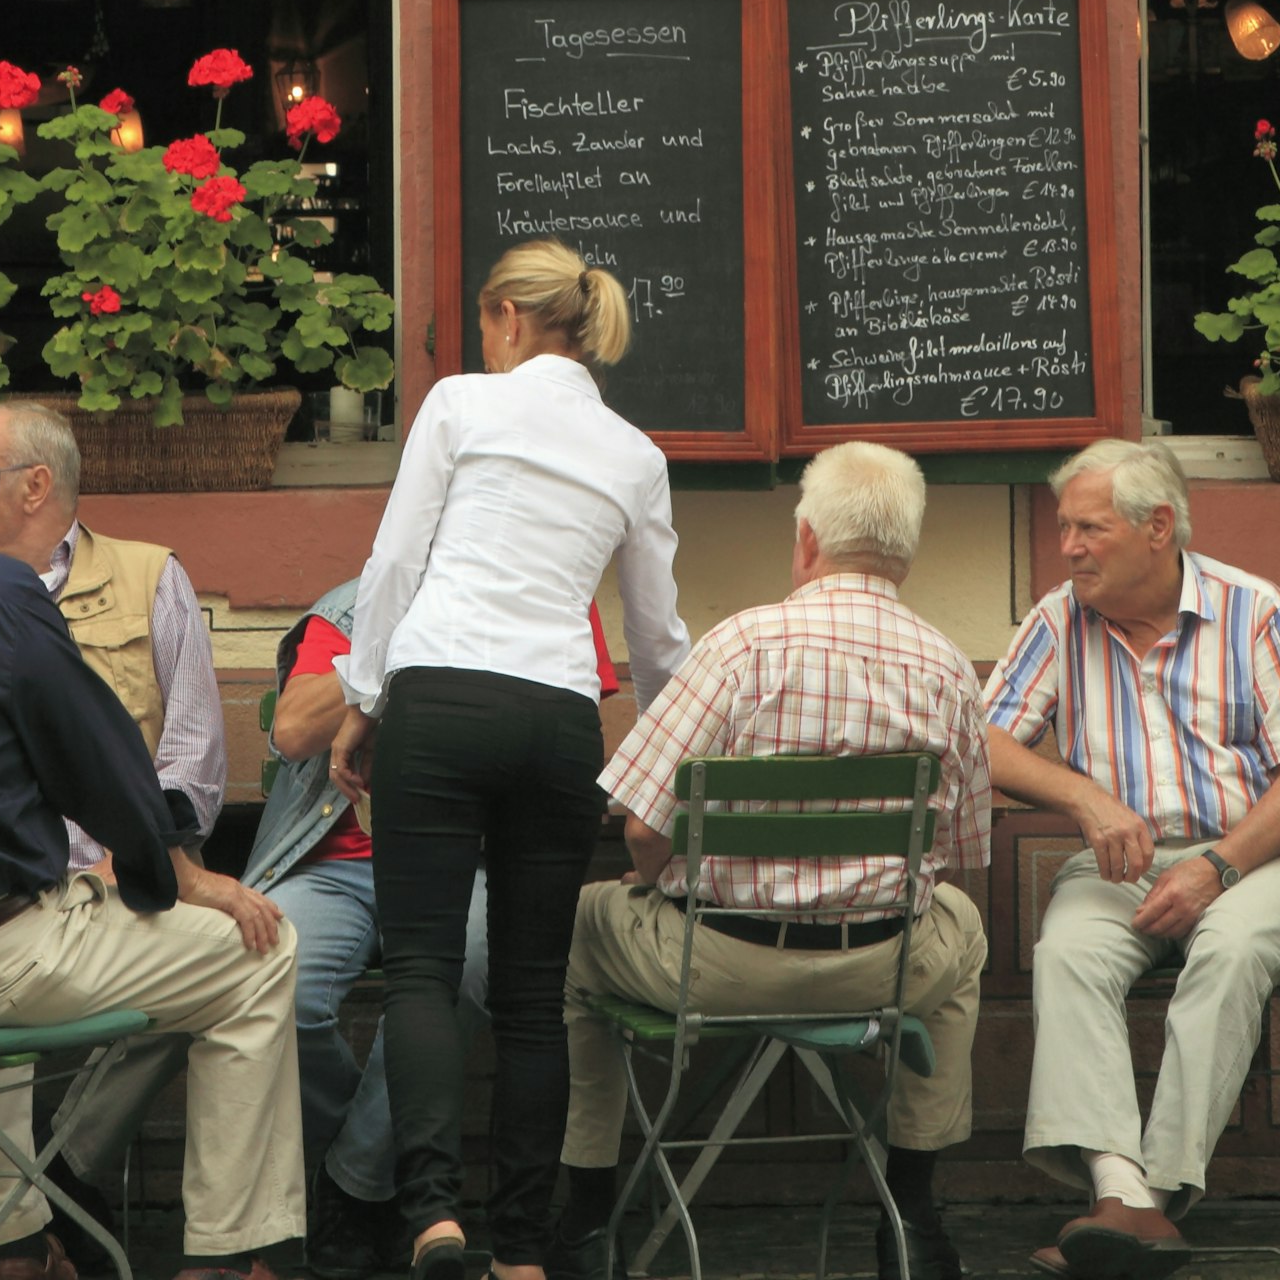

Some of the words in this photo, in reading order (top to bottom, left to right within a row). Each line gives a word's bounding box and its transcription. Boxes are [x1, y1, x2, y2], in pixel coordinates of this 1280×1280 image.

[535, 19, 686, 59] Tagesessen
[816, 47, 979, 87] Pfifferlingssuppe
[989, 42, 1016, 62] mit
[822, 75, 950, 102] Sahnehaube
[1028, 71, 1066, 87] 5.90
[504, 88, 644, 119] Fischteller
[823, 110, 884, 145] Großer
[893, 99, 1020, 128] Sommersalat
[1027, 102, 1055, 119] mit
[572, 129, 645, 152] Zander
[662, 128, 703, 148] und
[923, 129, 1026, 164] Pfifferlingen
[497, 166, 602, 199] Forellenfilet
[620, 171, 651, 186] an
[927, 159, 1007, 193] gebratenes
[497, 208, 643, 235] Kräutersauce
[660, 198, 701, 224] und
[830, 192, 870, 222] filet
[879, 191, 905, 208] und
[911, 182, 1010, 220] Pfifferlingen
[826, 219, 937, 250] Hausgemachte
[1029, 261, 1081, 290] Rösti
[834, 327, 858, 338] an
[1042, 328, 1067, 355] auf
[825, 363, 1012, 409] Pfifferlingsrahmsauce
[1031, 351, 1087, 378] Rösti
[991, 386, 1063, 410] 17.90
